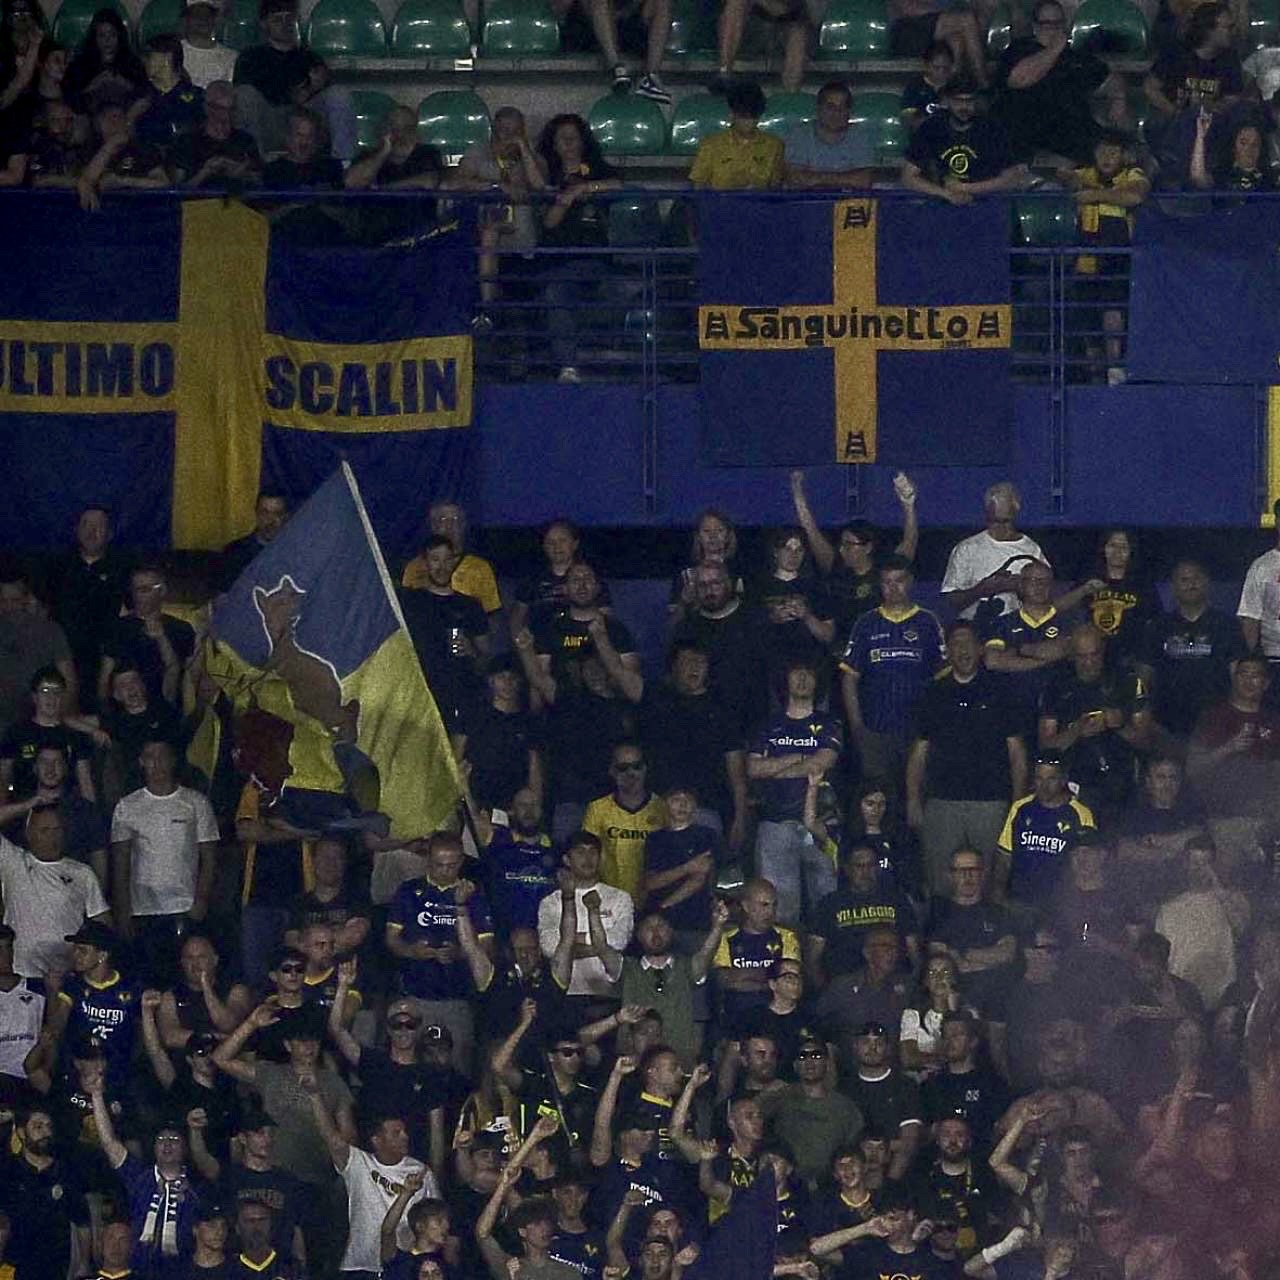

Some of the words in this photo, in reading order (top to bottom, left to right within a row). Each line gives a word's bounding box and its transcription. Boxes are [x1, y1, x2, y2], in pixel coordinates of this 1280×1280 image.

[737, 308, 968, 346] Sanguinetto
[0, 341, 173, 398] LTIMO
[265, 355, 457, 418] SCALIN
[1020, 831, 1066, 852] Sinergy
[837, 905, 896, 924] VILLAGGIO
